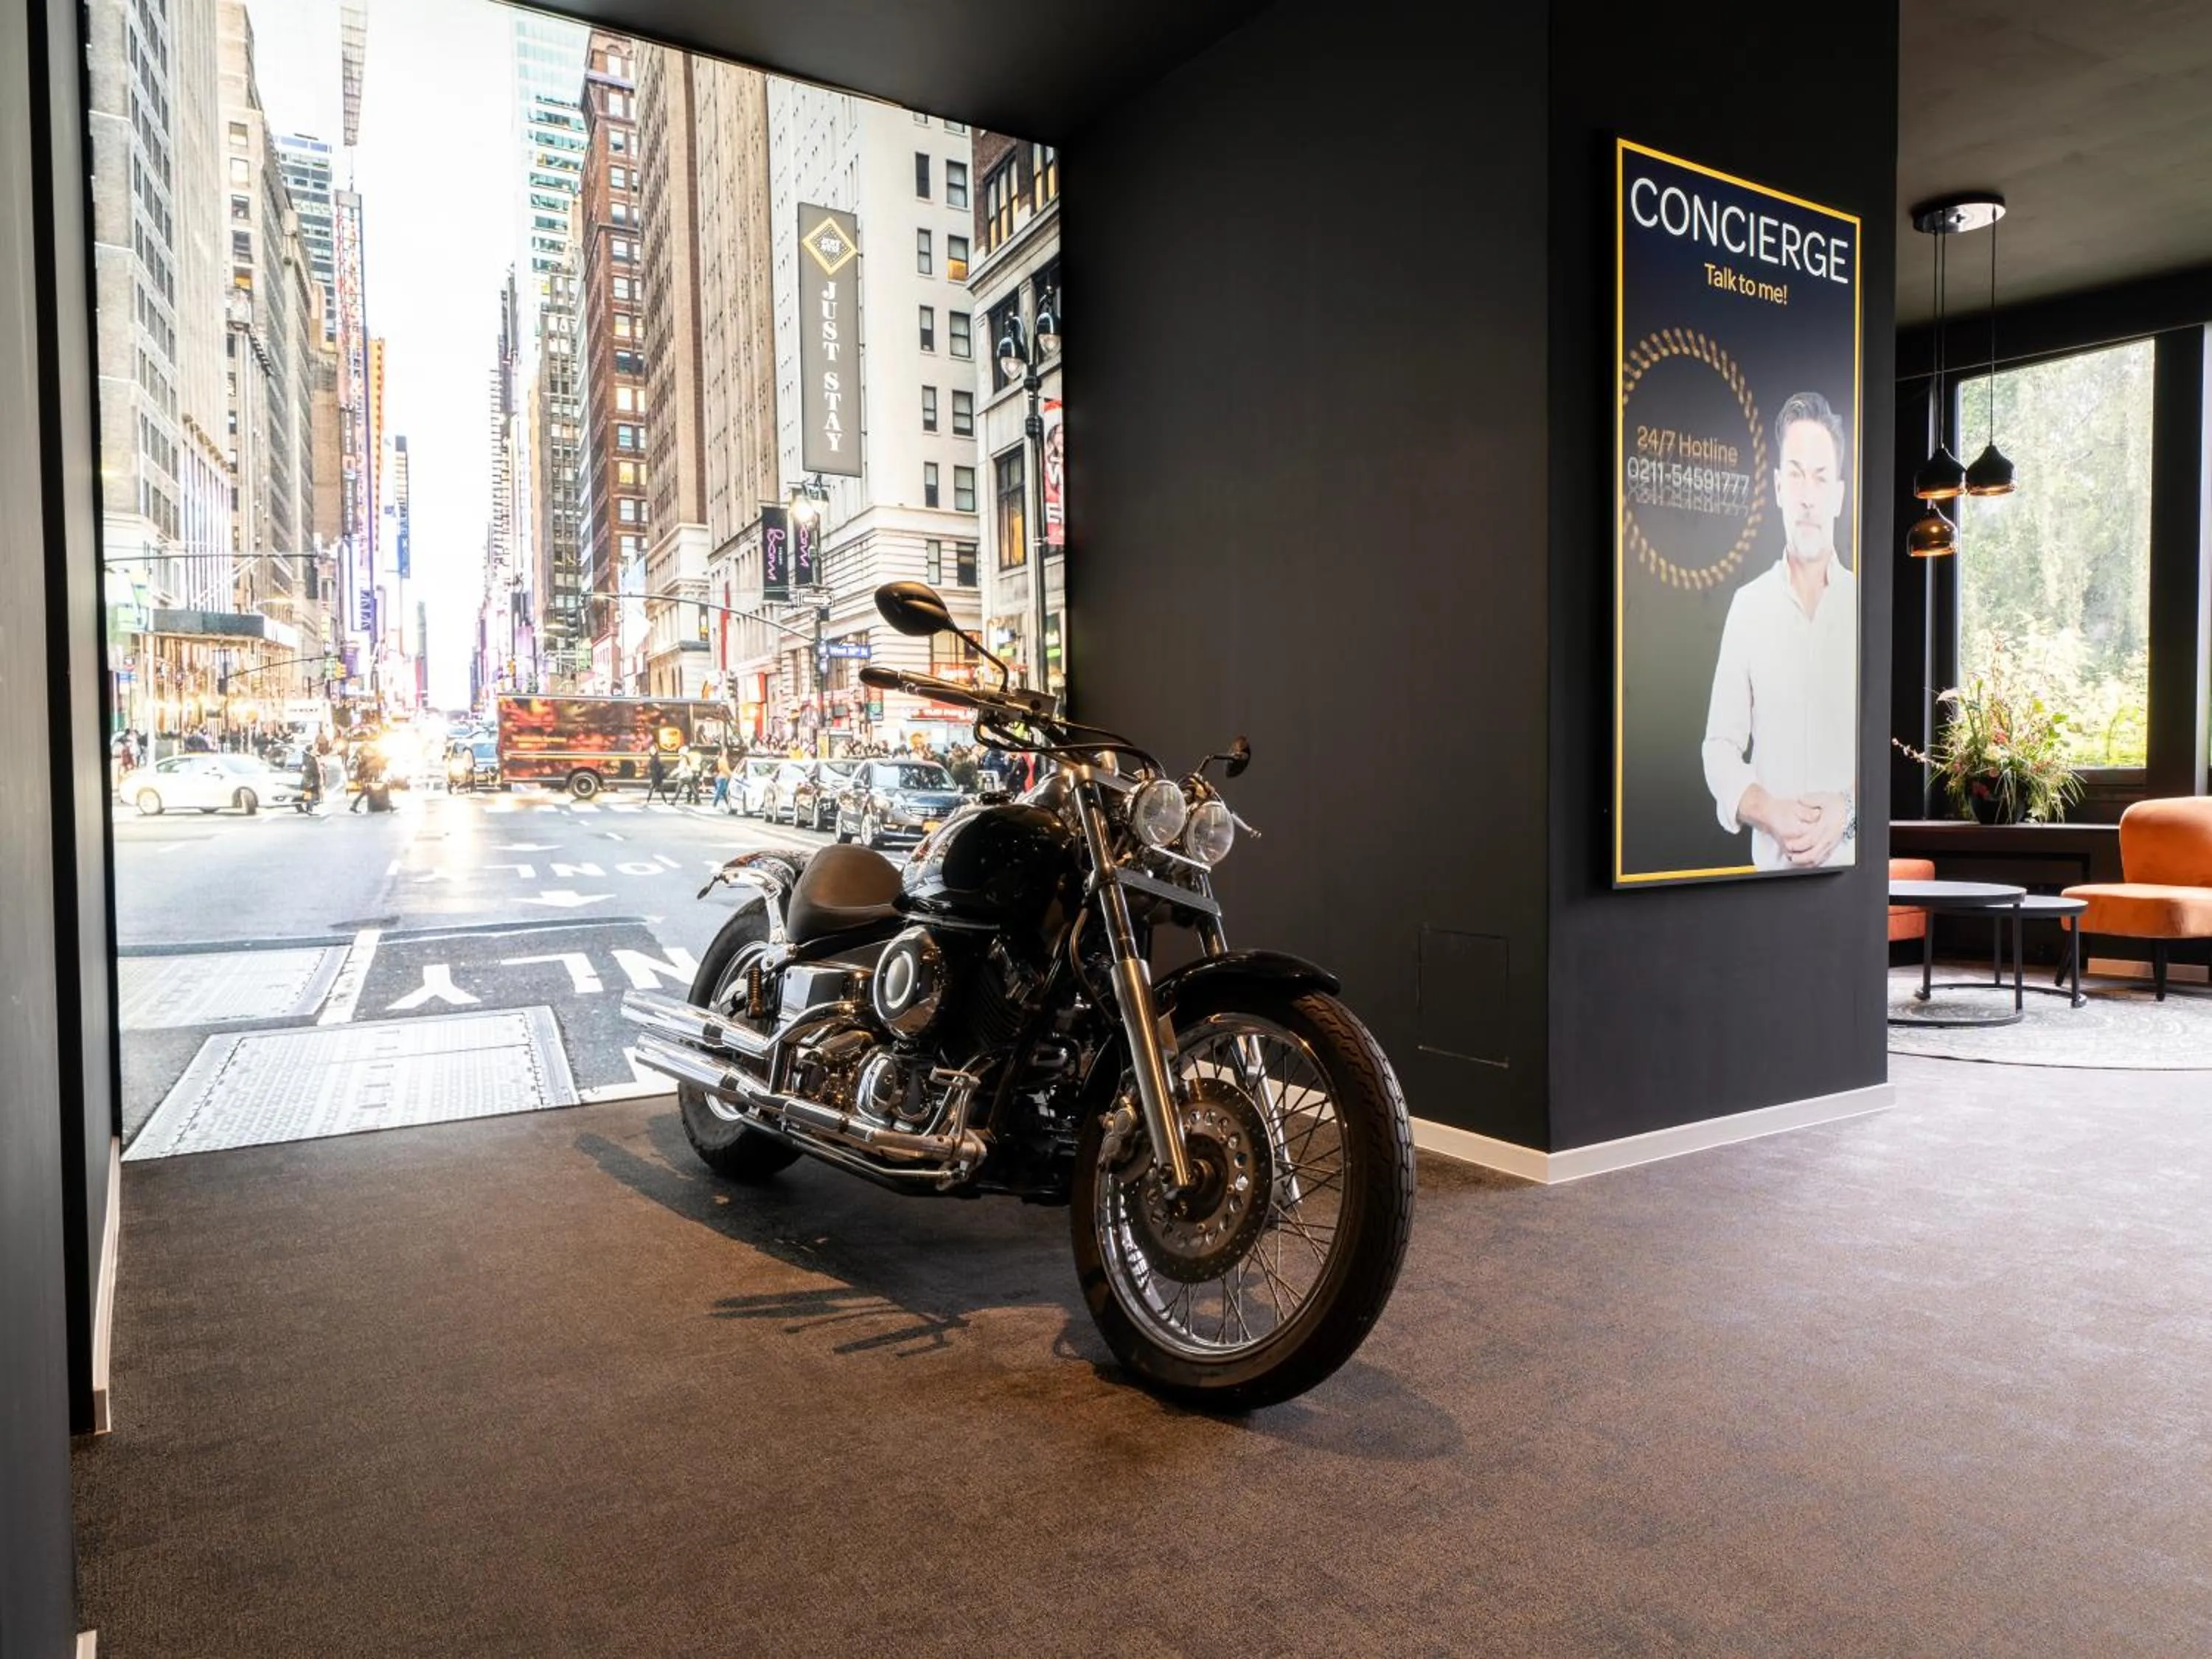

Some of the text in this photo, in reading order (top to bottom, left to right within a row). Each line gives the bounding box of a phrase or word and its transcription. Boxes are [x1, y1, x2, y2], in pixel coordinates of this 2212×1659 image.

[1630, 177, 1848, 284] CONCIERGE
[1704, 262, 1787, 305] Talk to me!
[821, 281, 844, 451] JUST STAY
[1637, 425, 1739, 467] 24/7 Hotline
[385, 947, 700, 1009] NLY
